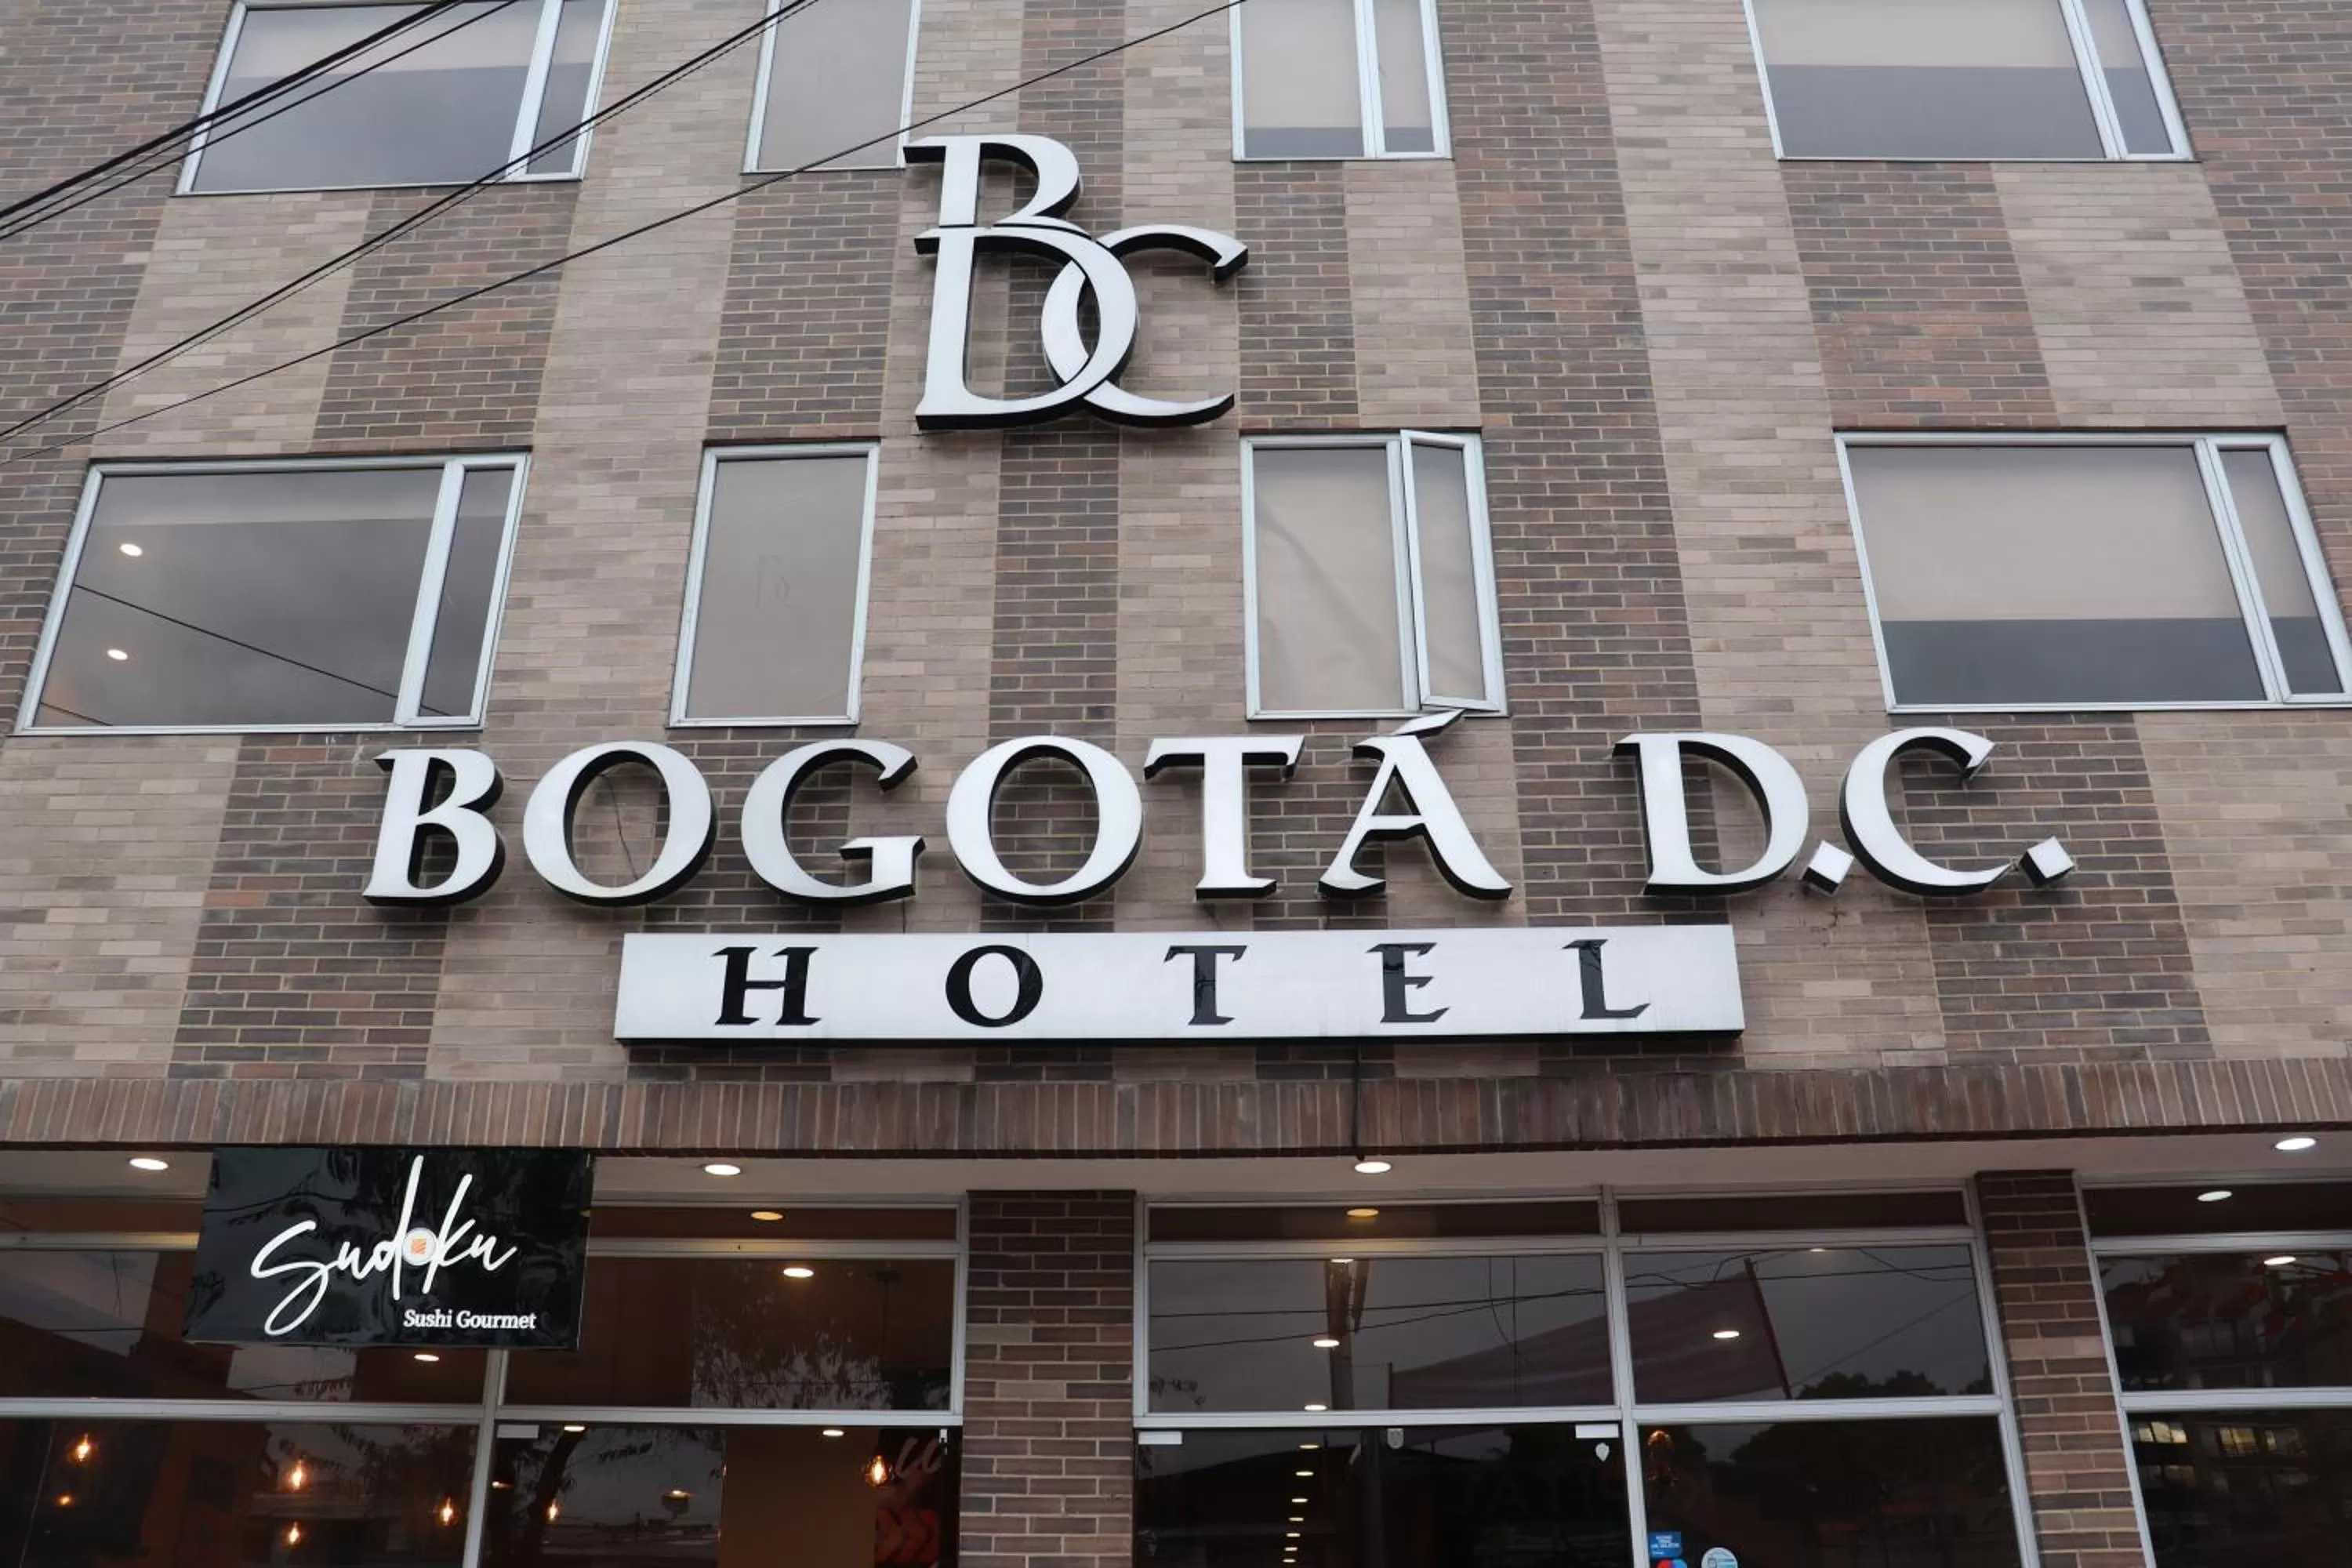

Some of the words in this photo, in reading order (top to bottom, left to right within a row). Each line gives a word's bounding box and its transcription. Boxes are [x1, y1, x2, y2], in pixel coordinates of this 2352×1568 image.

[362, 708, 1512, 906] BOGOTÁ
[1611, 727, 2074, 896] D.C.
[710, 938, 1651, 1029] HOTEL
[250, 1154, 517, 1336] Sudoku
[402, 1308, 452, 1329] Sushi
[456, 1310, 536, 1330] Gourmet
